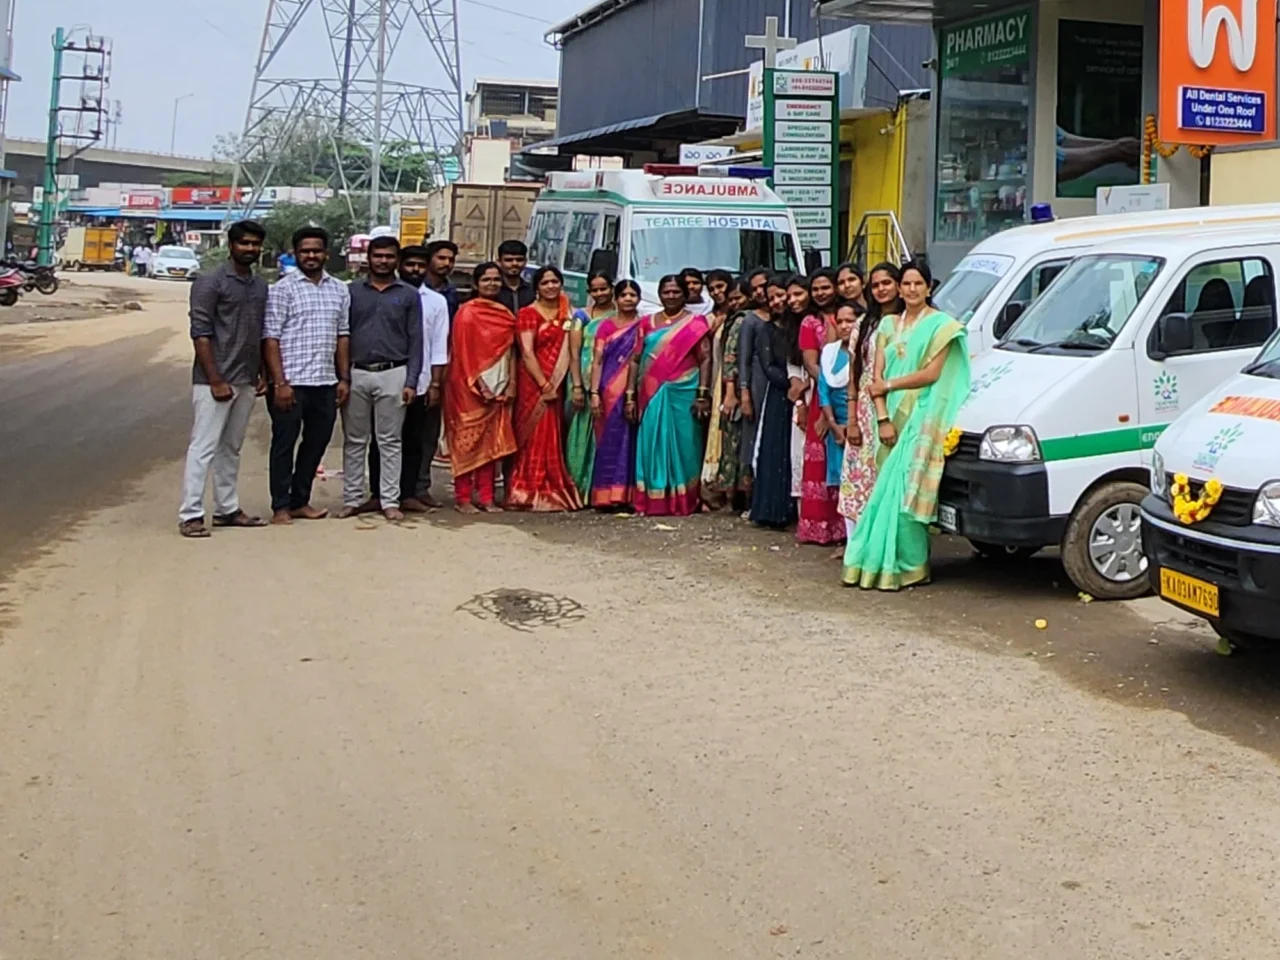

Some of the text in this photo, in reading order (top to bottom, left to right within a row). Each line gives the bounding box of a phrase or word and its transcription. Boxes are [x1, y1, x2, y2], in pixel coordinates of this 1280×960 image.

[946, 14, 1027, 55] PHARMACY
[1185, 88, 1262, 105] All Dental Services
[1191, 102, 1257, 117] Under One Roof
[645, 217, 703, 228] TEATREE
[707, 216, 779, 230] HOSPITAL
